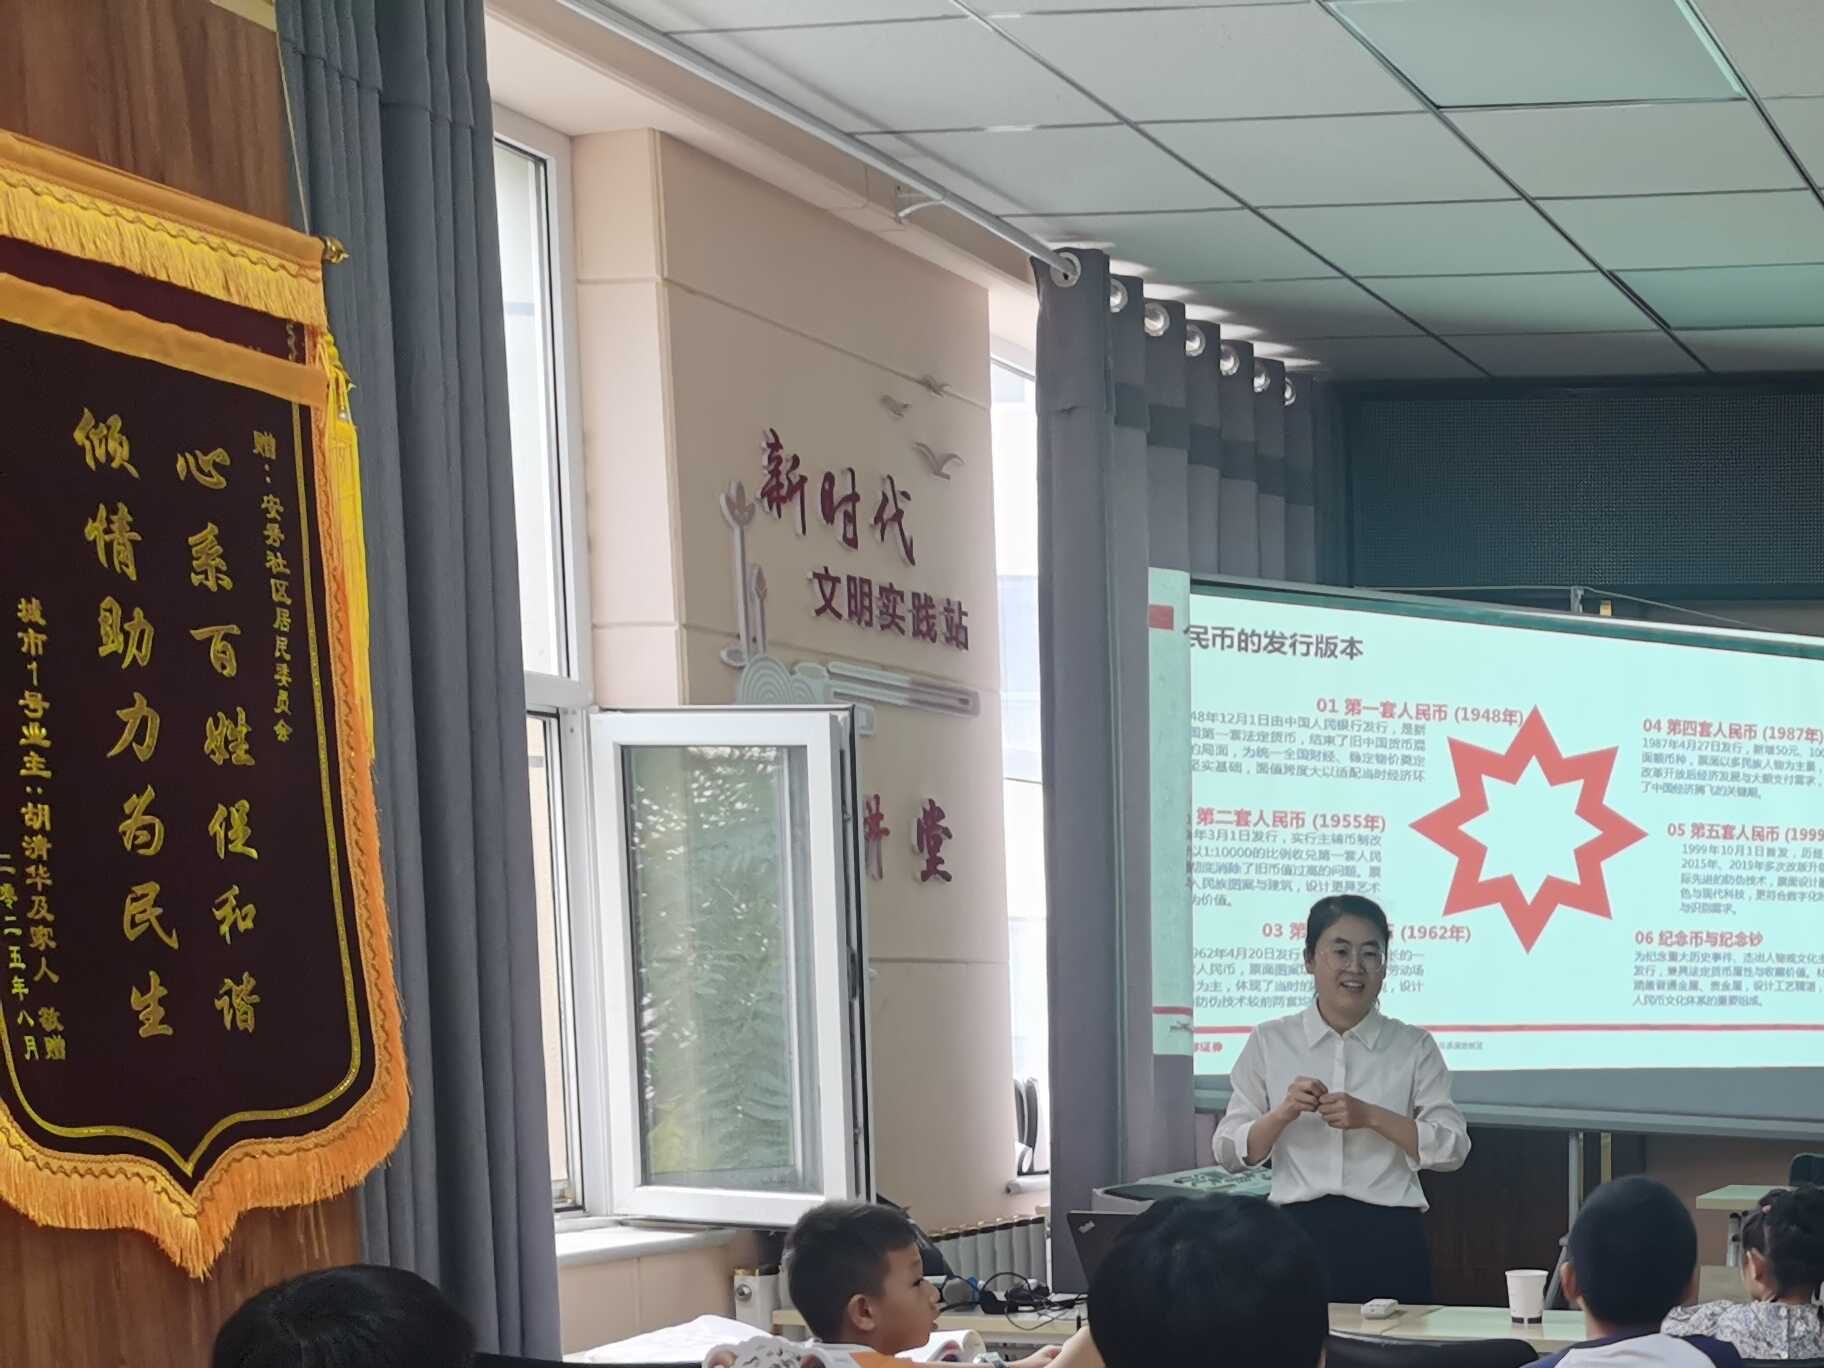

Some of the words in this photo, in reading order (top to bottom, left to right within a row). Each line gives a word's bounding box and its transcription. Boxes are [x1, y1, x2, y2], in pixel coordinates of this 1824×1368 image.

[757, 428, 915, 566] 新时代
[811, 566, 969, 651] 文明实践站
[1184, 625, 1364, 661] 民币的发行版本
[73, 406, 179, 1038] 倾情助力为民生
[1316, 698, 1338, 713] 01
[1344, 698, 1448, 722] 第一套人民币
[1454, 706, 1524, 727] (1948年)
[176, 446, 261, 1033] 心系百姓促和谐
[1642, 718, 1661, 733] 04
[1666, 718, 1758, 740] 第四套人民币
[1762, 726, 1824, 745] (1987年)
[1196, 807, 1306, 829] 第二套人民币
[1312, 813, 1386, 832] (1955年)
[1667, 823, 1686, 837] 05
[1690, 822, 1780, 842] 第五套人民币
[1262, 922, 1284, 938] 03
[1400, 924, 1472, 943] (1962年)
[1634, 930, 1655, 945] 06
[1658, 930, 1764, 948] 纪念币与纪念钞
